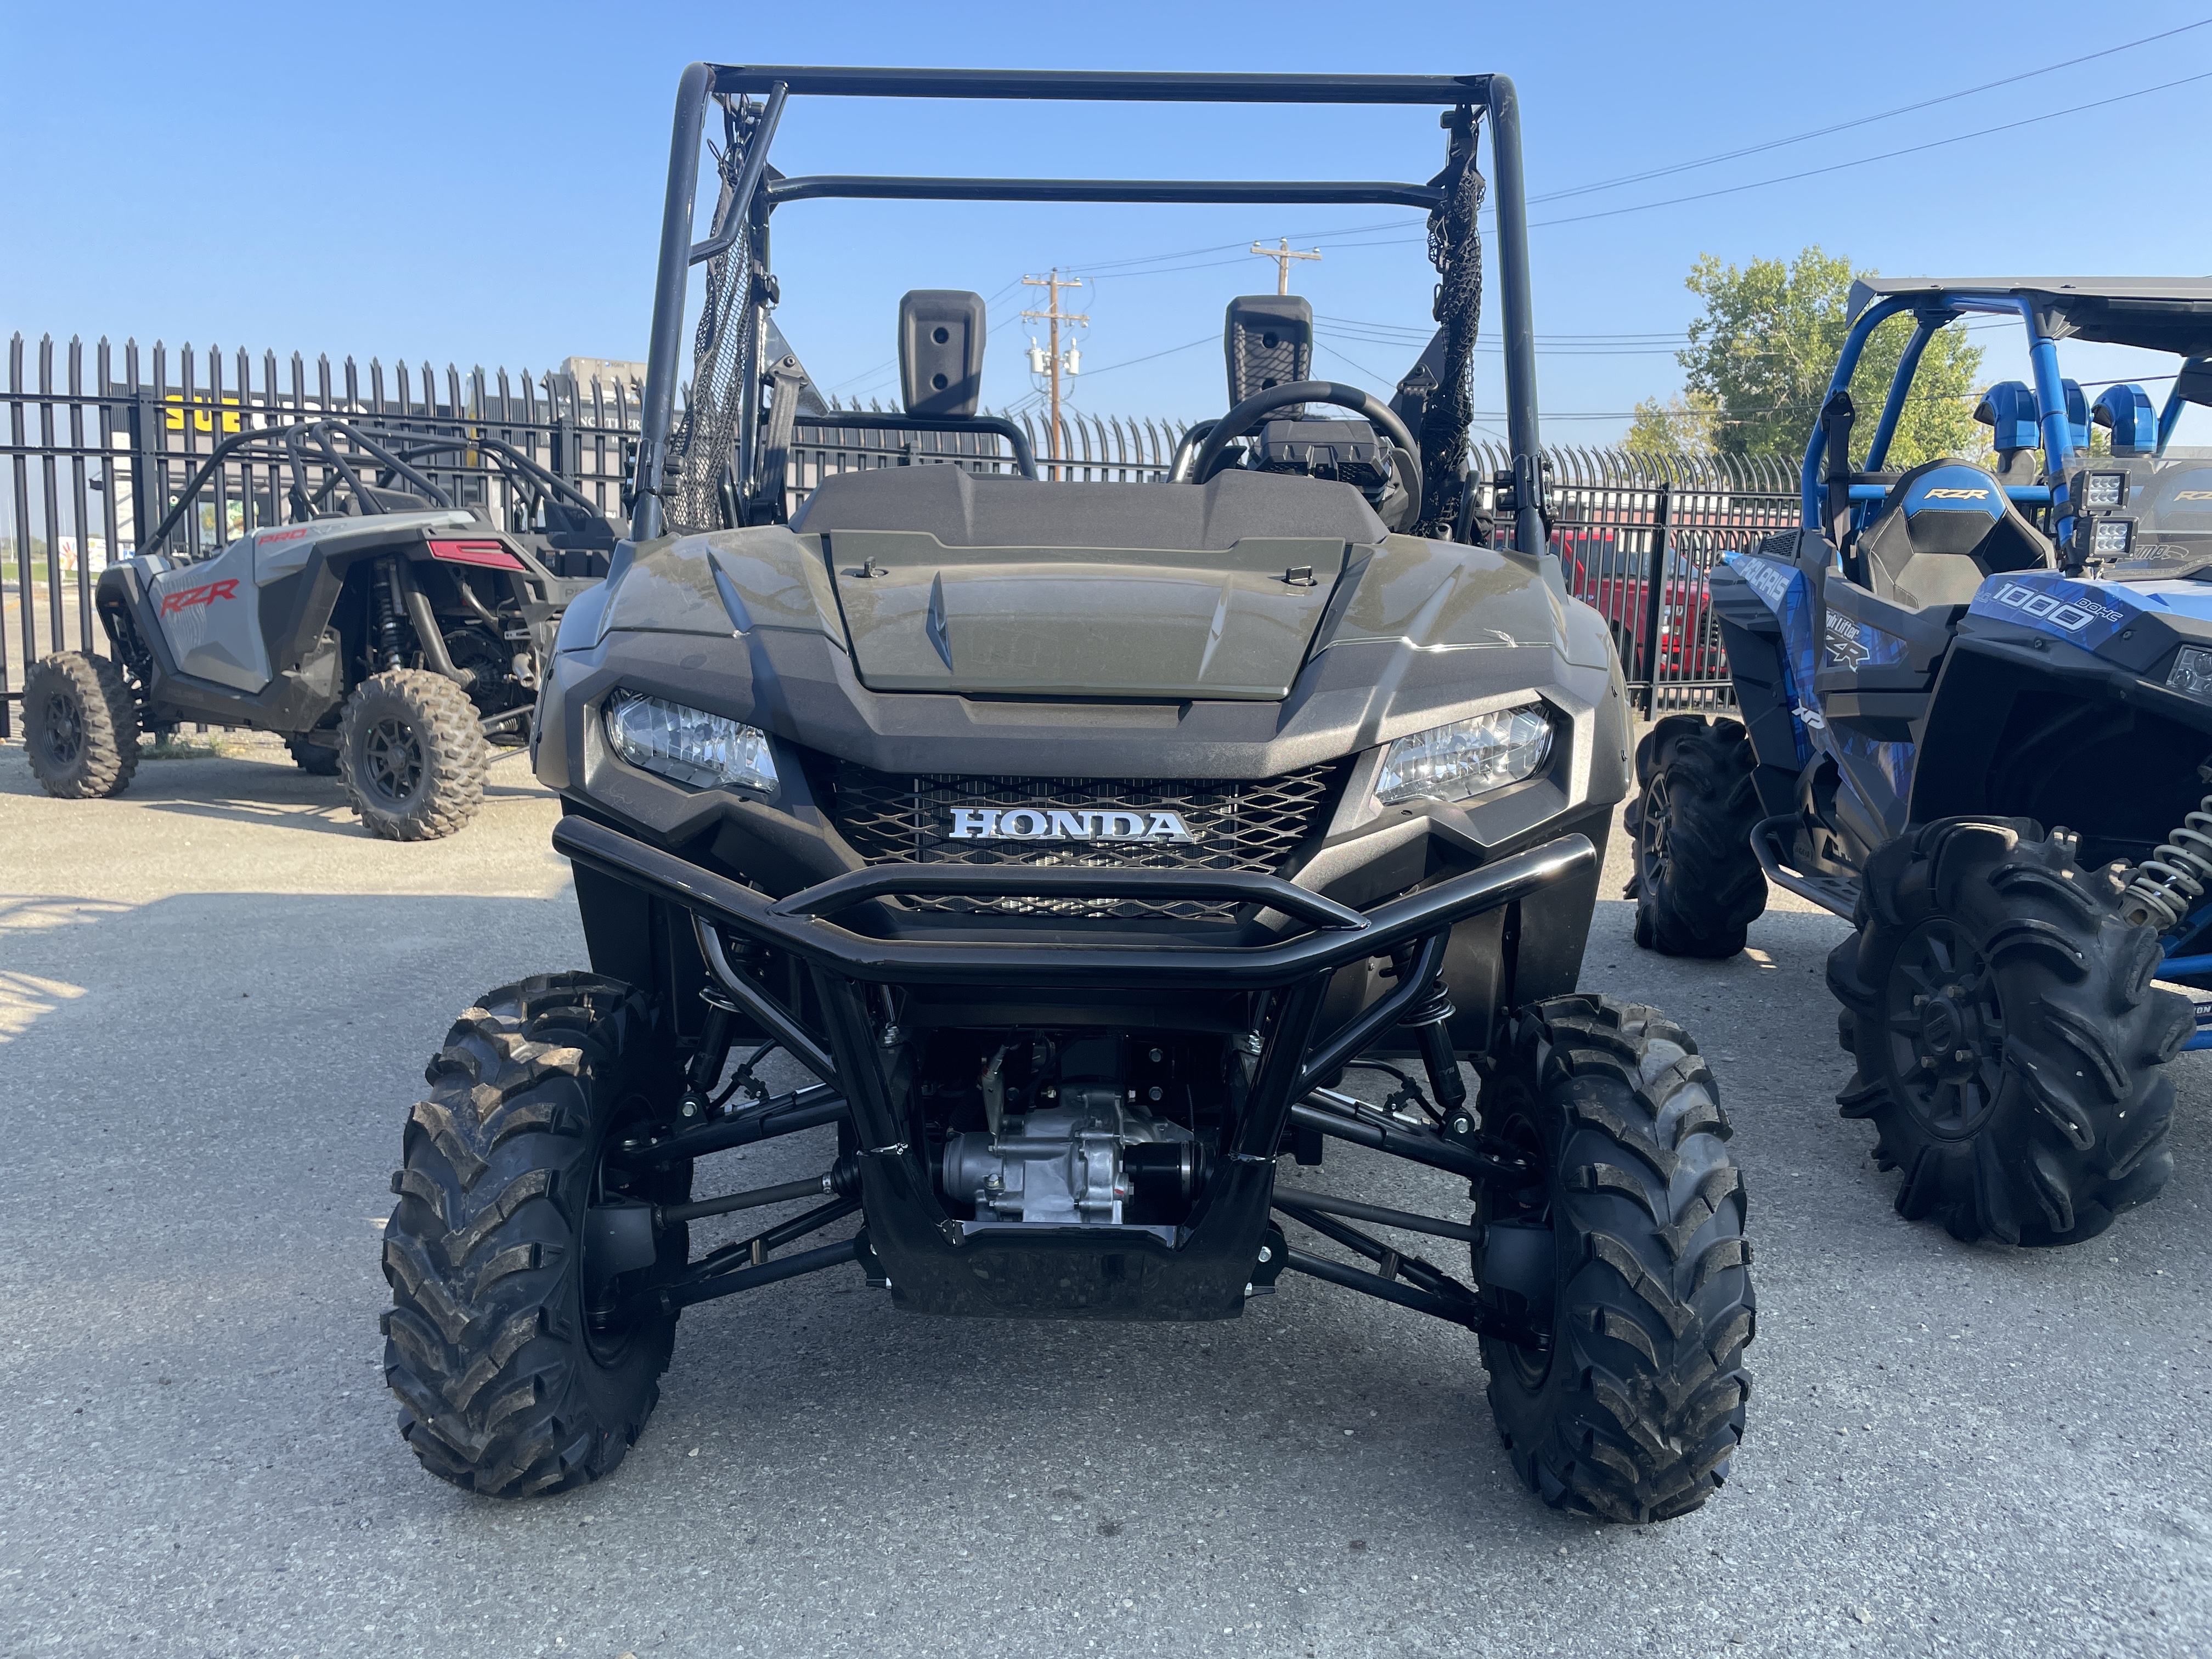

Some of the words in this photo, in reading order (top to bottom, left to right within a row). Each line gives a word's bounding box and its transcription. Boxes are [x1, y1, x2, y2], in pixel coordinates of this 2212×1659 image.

[1923, 488, 1990, 500] RZR
[2173, 490, 2212, 502] RZ
[258, 528, 307, 546] PRO
[1740, 558, 1790, 602] POLARIS
[161, 578, 240, 618] RZR
[1992, 582, 2096, 631] 1000
[2073, 597, 2124, 622] DOHC
[1826, 610, 1838, 629] igh
[1834, 617, 1860, 640] Lifter
[1826, 634, 1870, 673] ZR
[1791, 698, 1825, 730] XP
[949, 806, 1195, 844] HONDA
